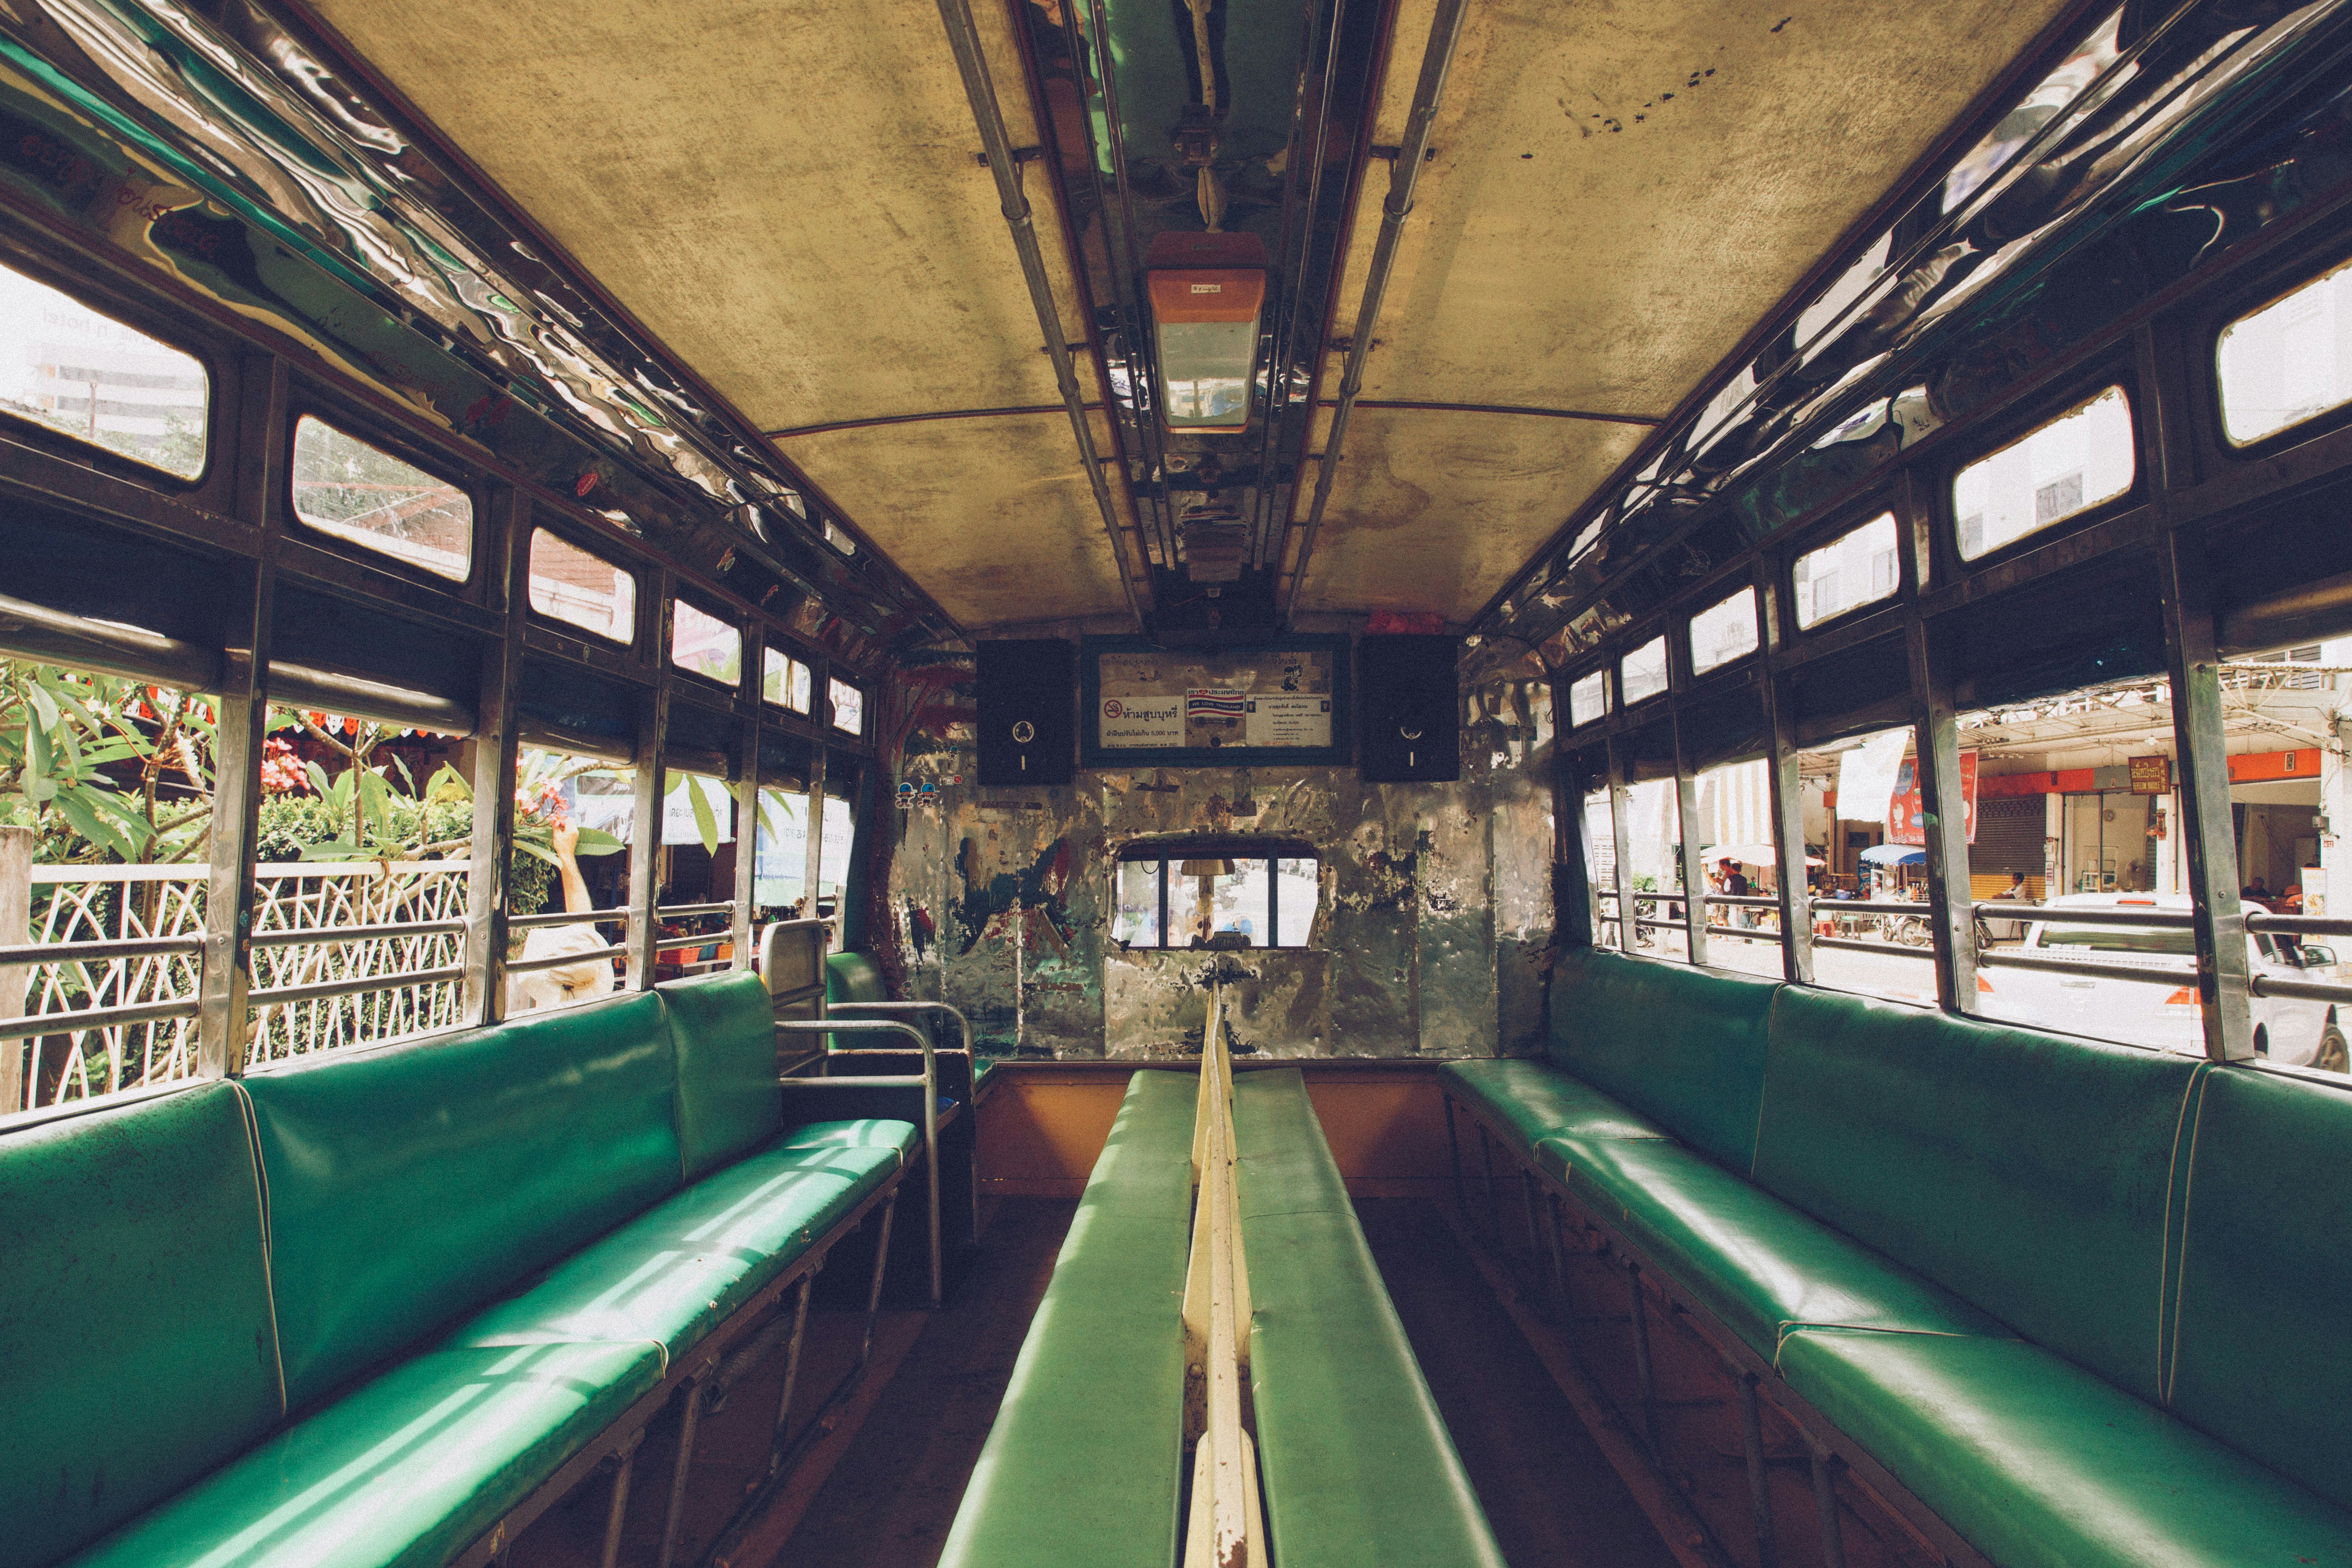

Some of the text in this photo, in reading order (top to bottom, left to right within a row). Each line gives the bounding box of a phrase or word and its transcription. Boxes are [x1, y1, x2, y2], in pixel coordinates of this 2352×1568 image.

[1123, 705, 1178, 721] ห้ามสูบบุหรี่
